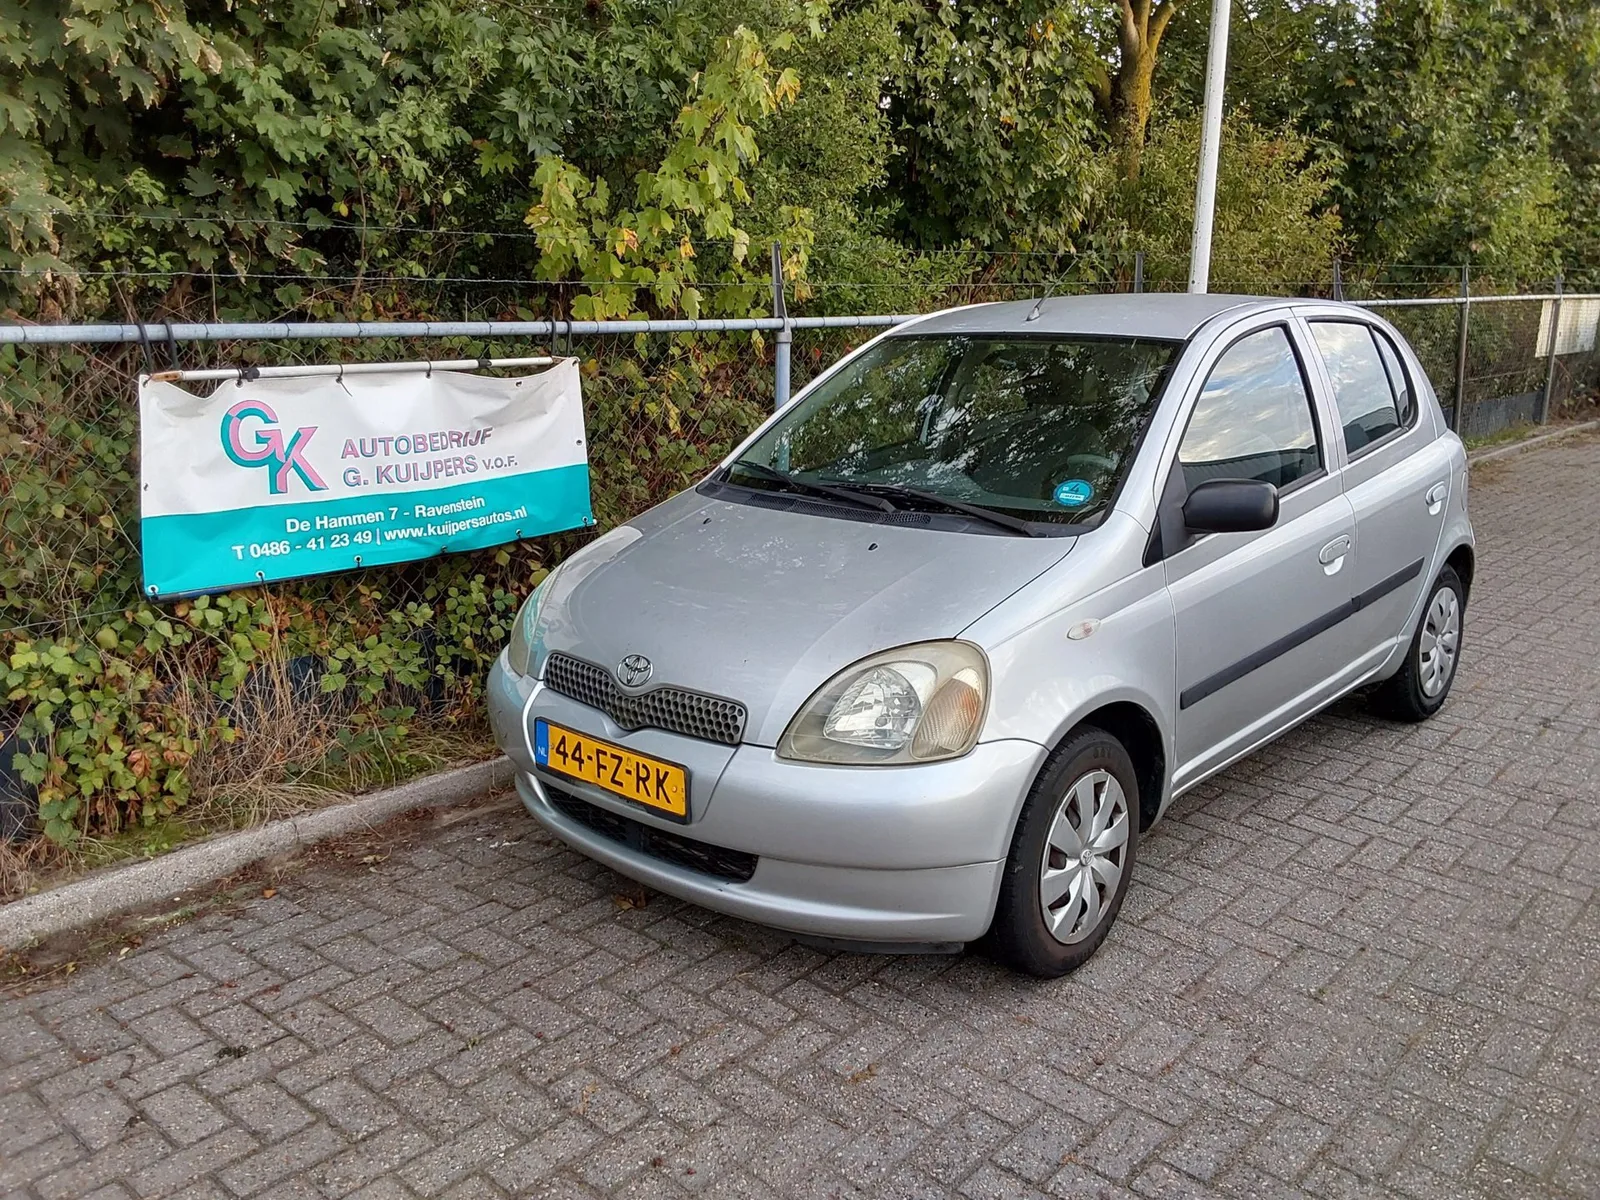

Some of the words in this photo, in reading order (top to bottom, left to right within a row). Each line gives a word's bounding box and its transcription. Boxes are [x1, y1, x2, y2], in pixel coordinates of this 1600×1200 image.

[220, 399, 330, 495] GK
[341, 427, 494, 459] AUTOBEDRIJF
[343, 466, 369, 487] G.
[376, 454, 479, 485] KUIJPERS
[482, 455, 519, 471] V.O.F.
[231, 545, 245, 560] T
[249, 540, 291, 558] 0486
[306, 536, 325, 551] 41
[330, 533, 350, 548] 23
[353, 530, 373, 544] 49
[384, 505, 528, 541] www.kuijpersautos.nl
[285, 518, 311, 533] De
[315, 511, 385, 530] Hammen
[388, 507, 399, 521] 7
[414, 496, 486, 518] Ravenstein
[537, 745, 548, 758] NL
[555, 734, 672, 804] 44-FZ-RK
